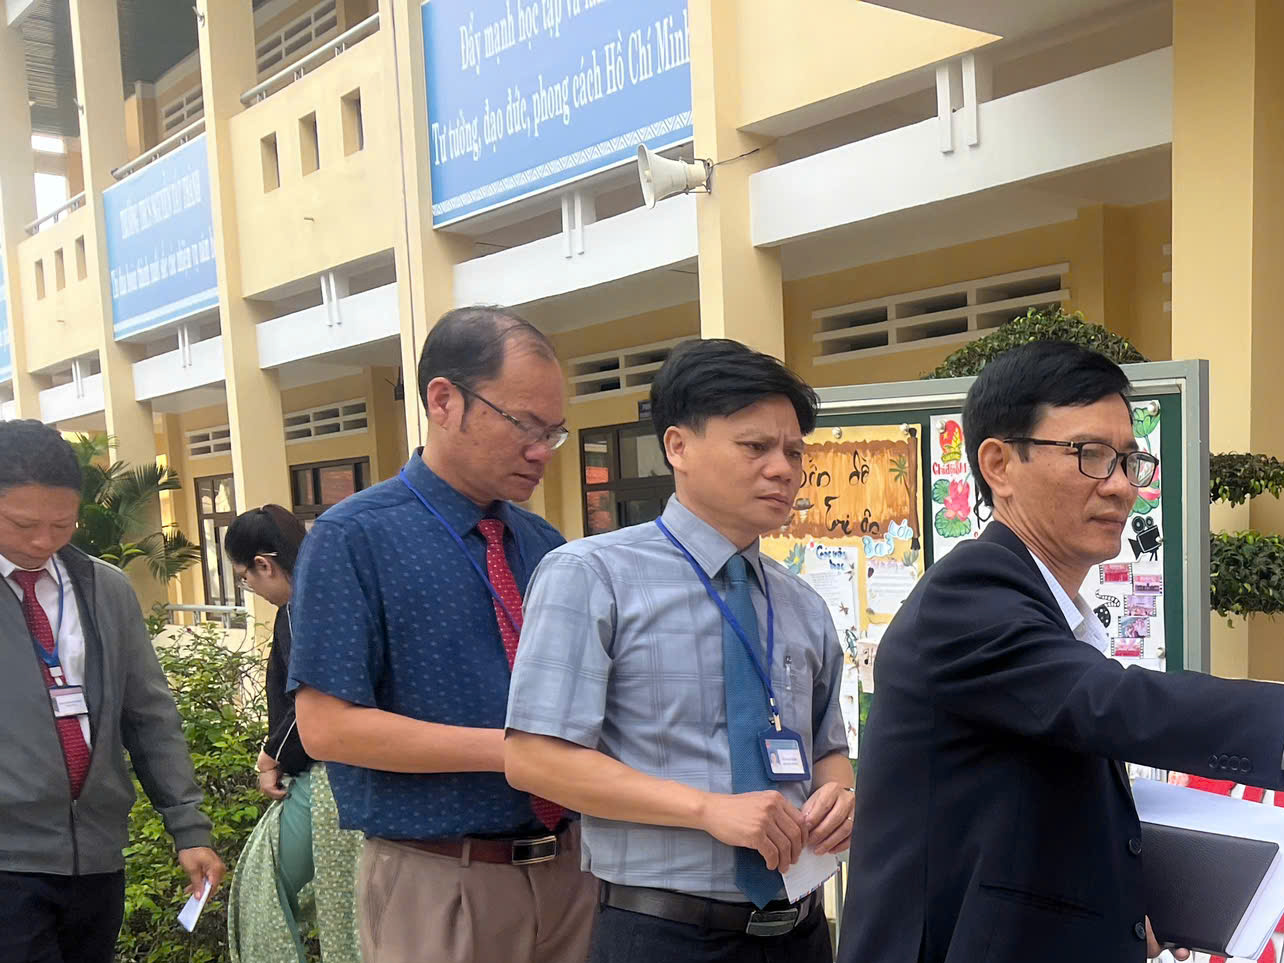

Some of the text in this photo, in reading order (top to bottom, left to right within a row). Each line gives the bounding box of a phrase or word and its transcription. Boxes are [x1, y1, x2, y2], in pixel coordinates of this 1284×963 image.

[484, 0, 515, 64] mạnh
[517, 0, 540, 50] học
[431, 121, 448, 166] Tư
[483, 98, 504, 152] đạo
[506, 85, 531, 137] đức,
[532, 73, 571, 137] phong
[572, 49, 603, 108] cách
[604, 29, 625, 95] Hồ
[628, 25, 653, 85] Chí
